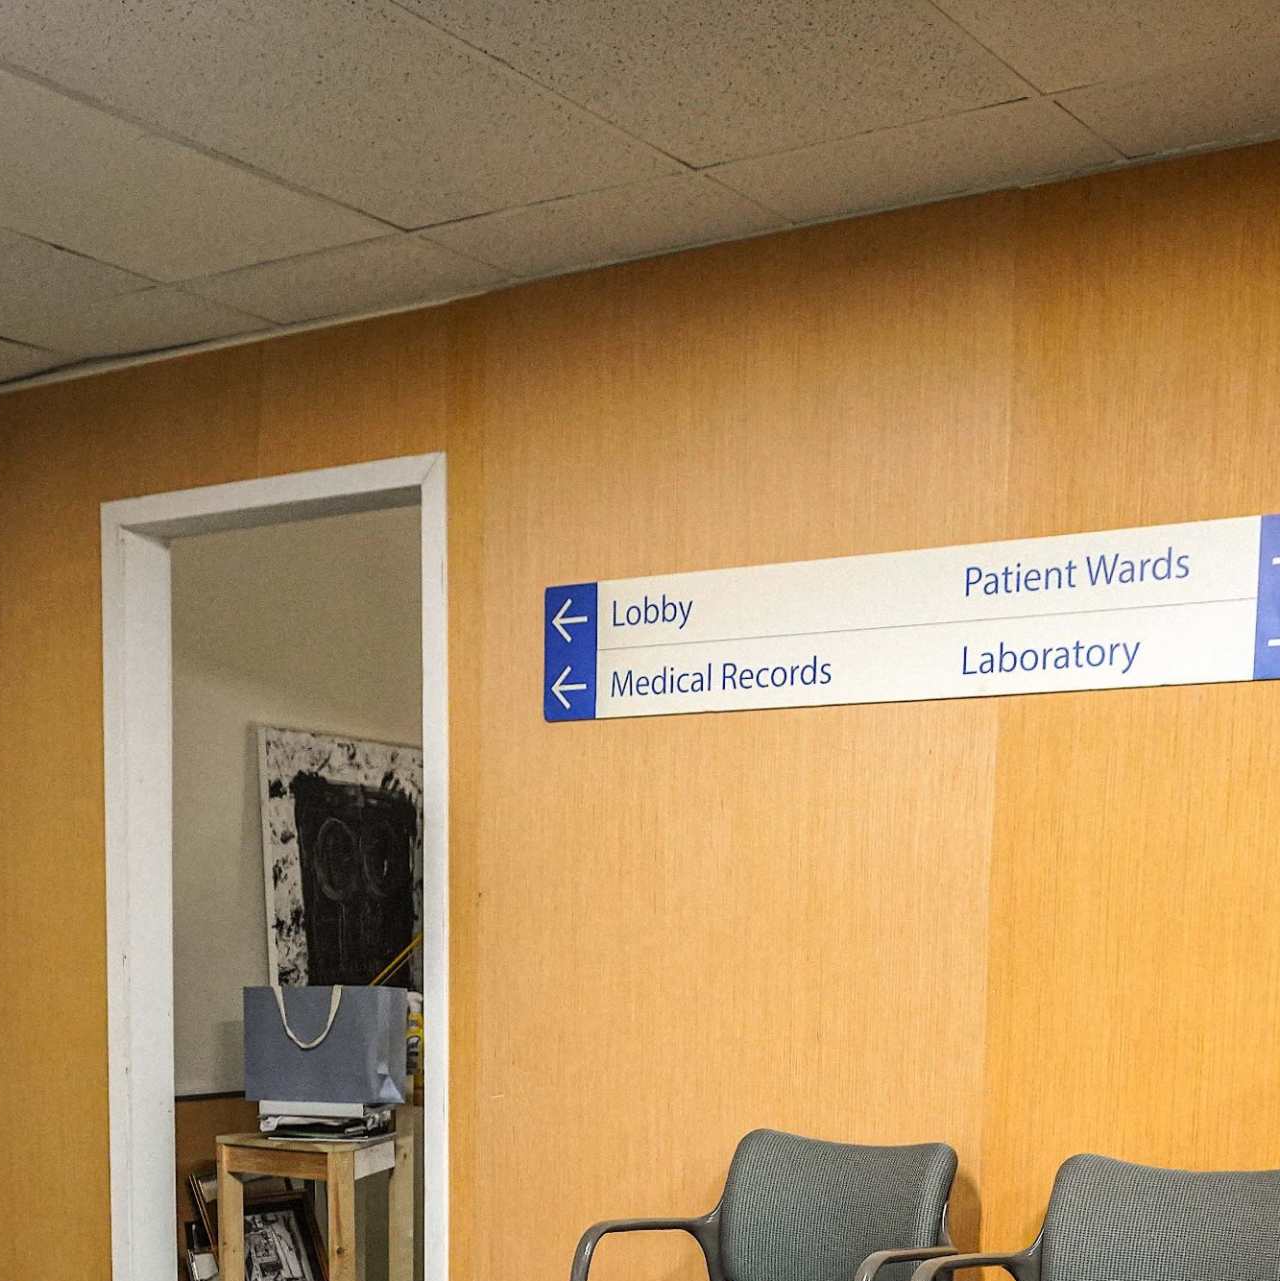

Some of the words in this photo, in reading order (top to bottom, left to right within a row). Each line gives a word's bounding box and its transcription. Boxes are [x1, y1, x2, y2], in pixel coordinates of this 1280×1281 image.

[965, 560, 1077, 597] Patient
[1086, 546, 1190, 586] Wards
[612, 594, 693, 630] Lobby
[611, 663, 712, 698] Medical
[722, 655, 832, 690] Records
[962, 640, 1141, 675] Laboratory
